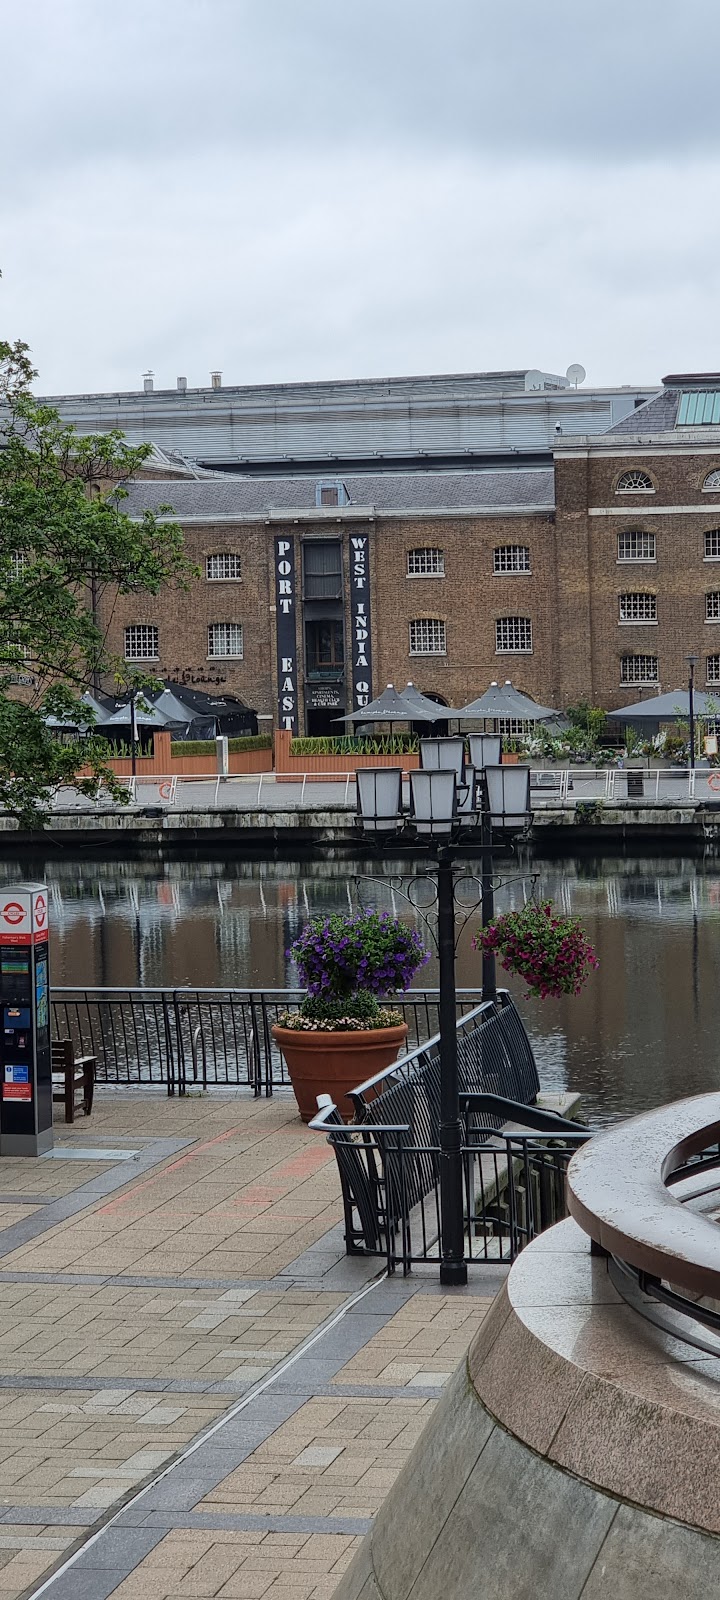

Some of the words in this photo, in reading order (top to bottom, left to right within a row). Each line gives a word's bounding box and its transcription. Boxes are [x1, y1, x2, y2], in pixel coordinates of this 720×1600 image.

[278, 541, 292, 614] PORT
[351, 537, 367, 589] WEST
[355, 603, 369, 667] INDIA
[281, 657, 294, 730] EAST
[356, 681, 369, 706] QU
